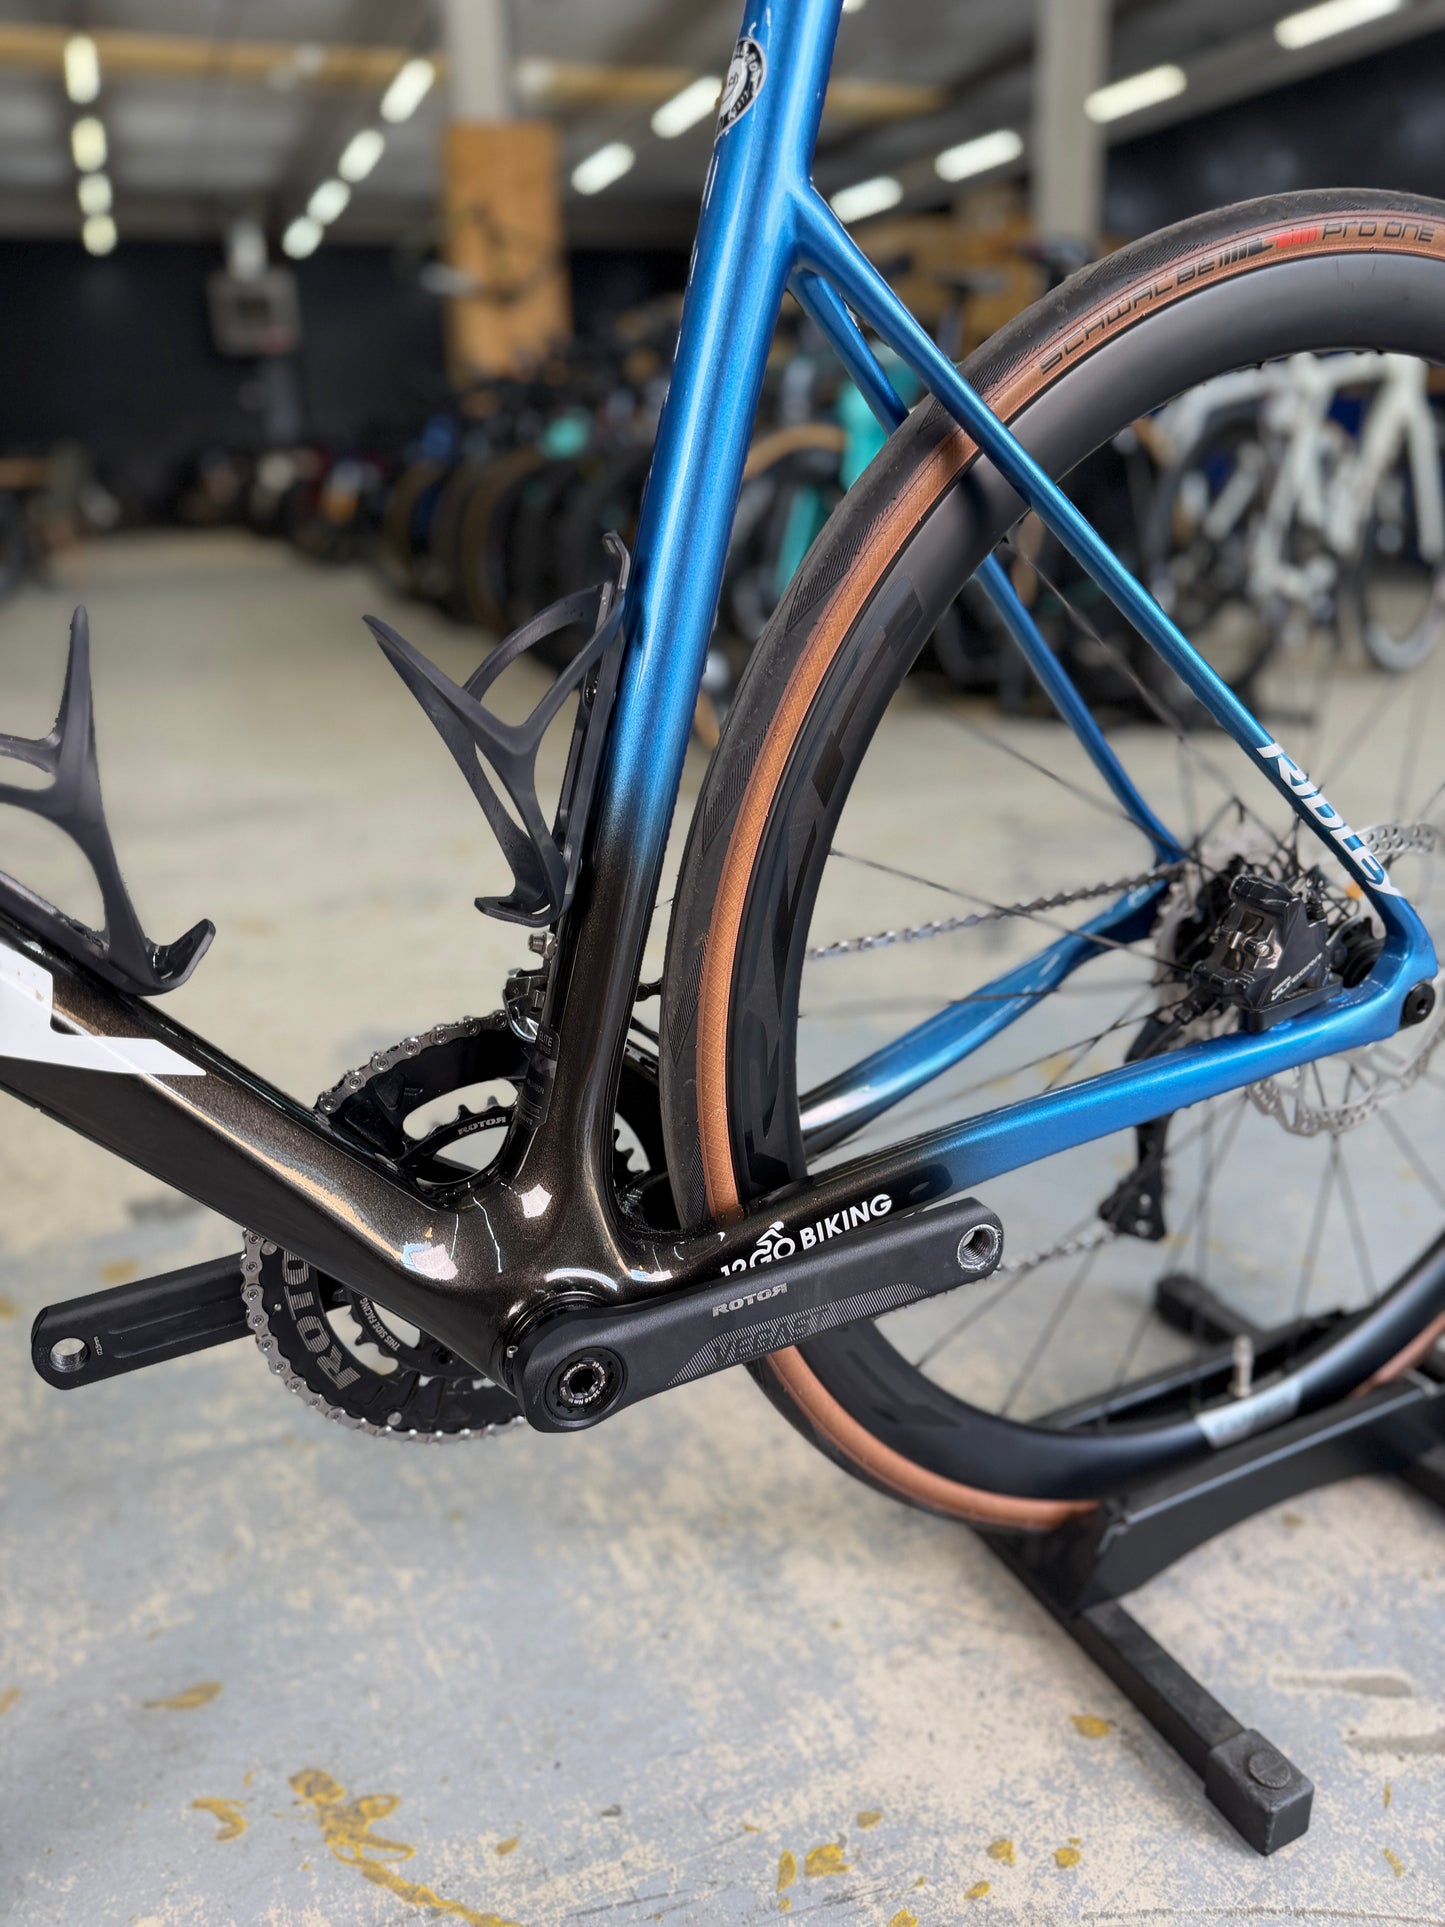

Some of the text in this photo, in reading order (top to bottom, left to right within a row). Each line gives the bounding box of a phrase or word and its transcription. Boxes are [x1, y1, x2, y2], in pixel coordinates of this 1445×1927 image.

[1039, 257, 1216, 375] SCHWALBE
[1256, 742, 1404, 898] RIDLEY
[538, 1030, 553, 1047] ELITE
[799, 1193, 893, 1250] BIKING
[359, 1297, 401, 1352] THIS SIDE FACING
[711, 1282, 788, 1318] ROTOR
